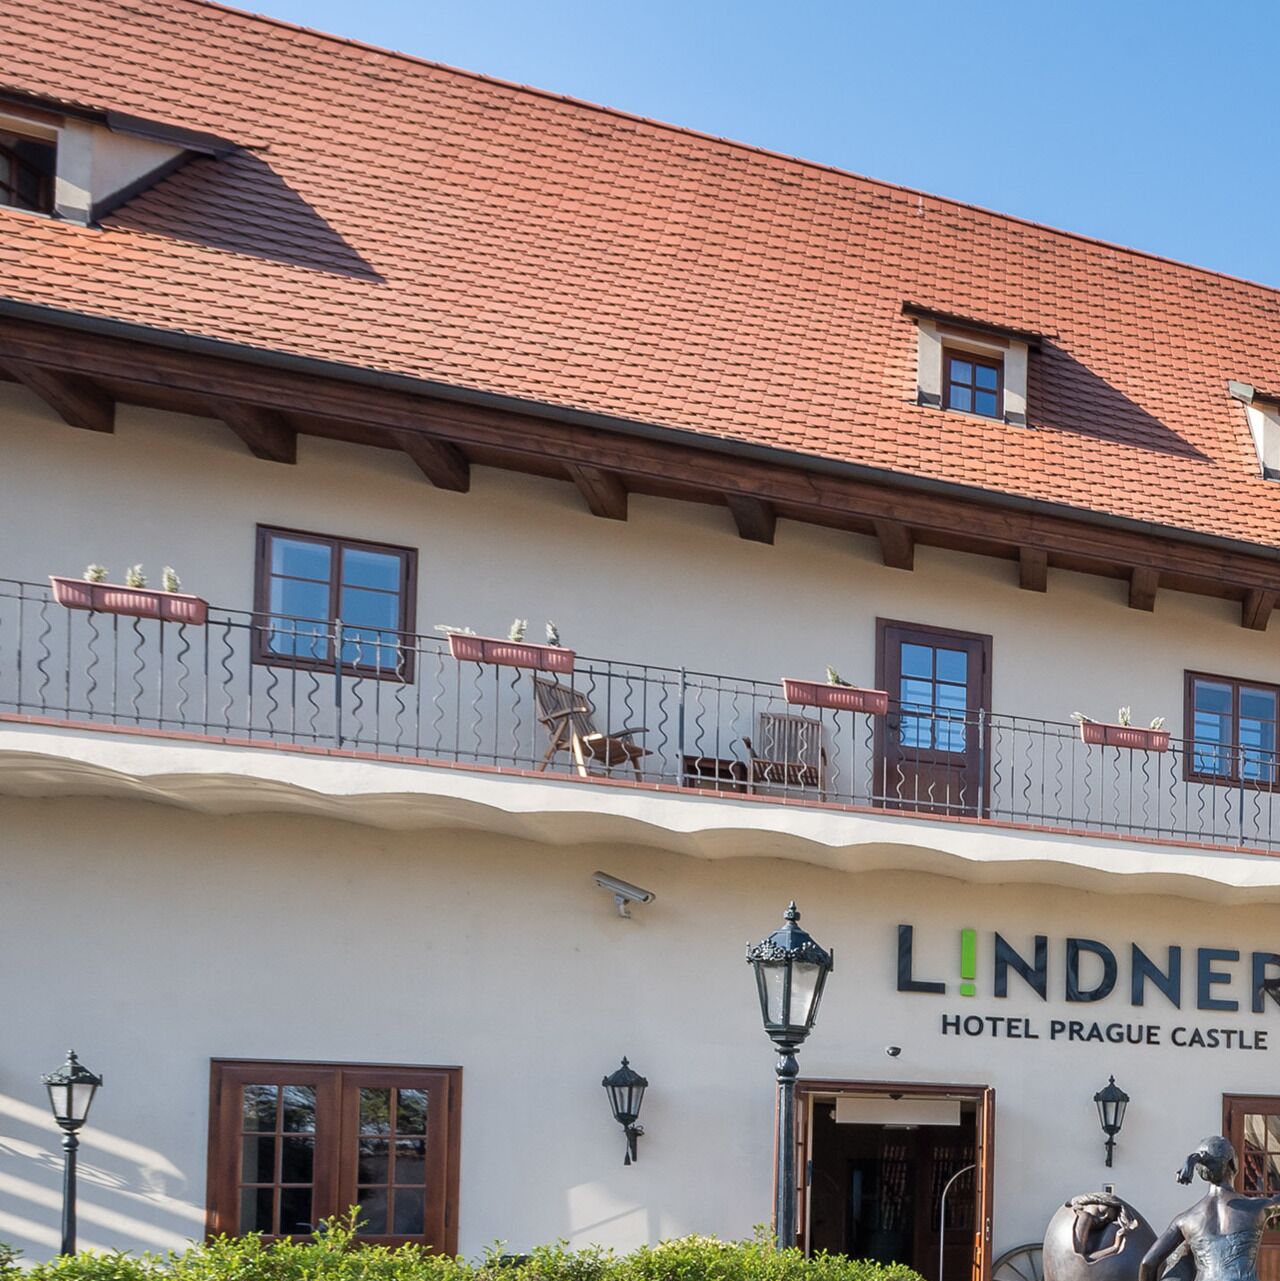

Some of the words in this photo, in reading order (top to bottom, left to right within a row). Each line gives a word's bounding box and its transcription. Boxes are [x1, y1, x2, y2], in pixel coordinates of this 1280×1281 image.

[941, 1014, 1039, 1039] HOTEL
[1050, 1019, 1161, 1045] PRAGUE
[1171, 1026, 1268, 1050] CASTLE
